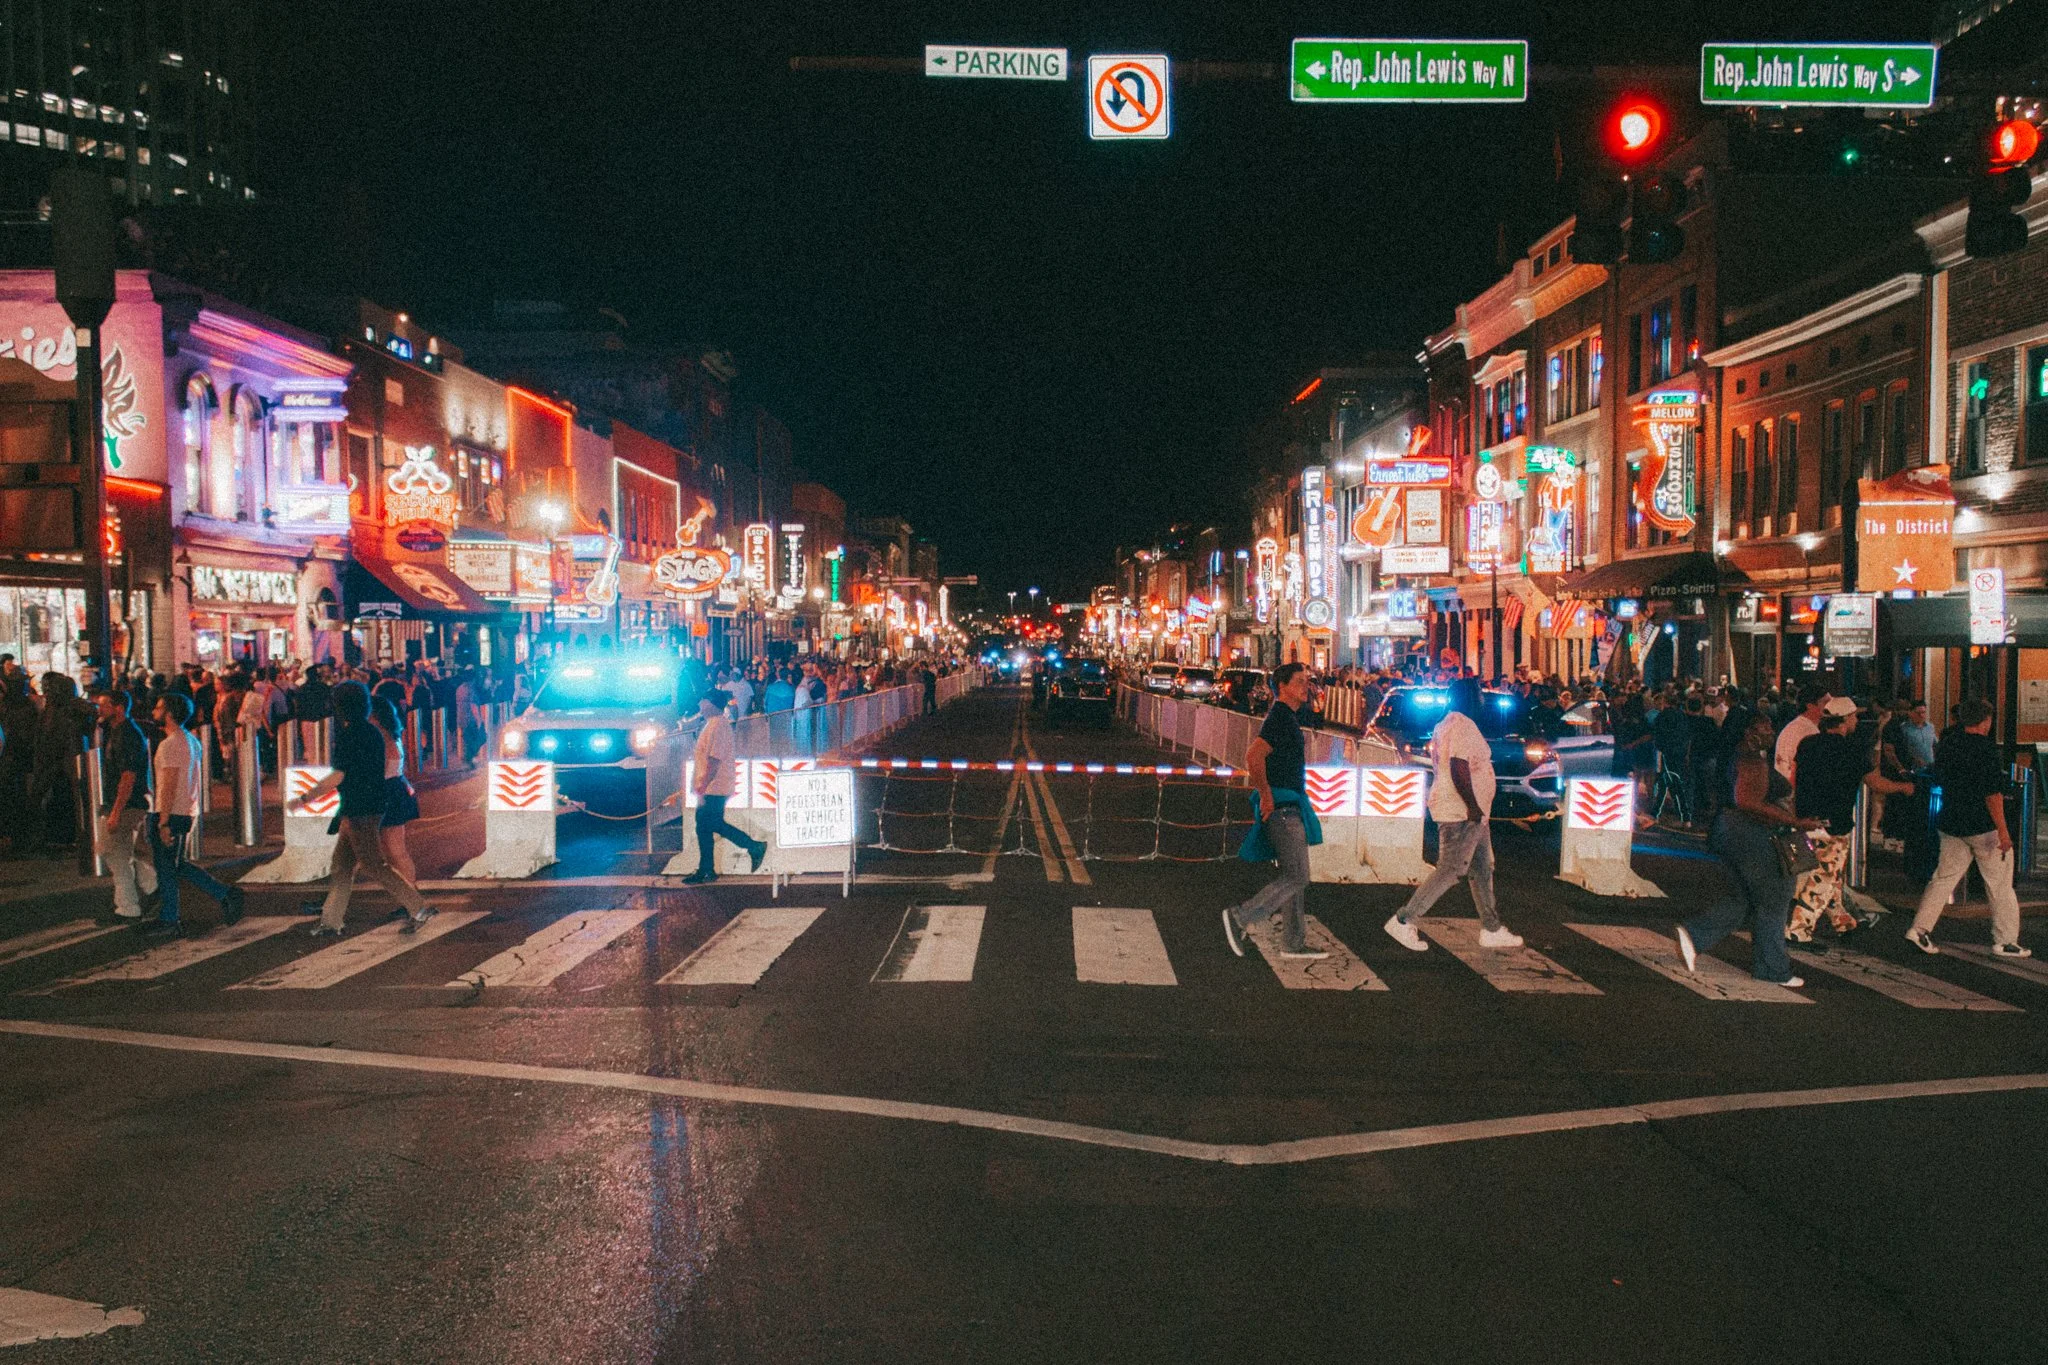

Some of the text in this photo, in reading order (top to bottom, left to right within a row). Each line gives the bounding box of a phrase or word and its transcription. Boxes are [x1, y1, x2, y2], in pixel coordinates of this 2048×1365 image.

[955, 51, 1060, 76] PARKING
[1331, 50, 1515, 91] Rep. John Lewis Way N
[1713, 54, 1894, 94] Rep. John Lewis Way S
[1651, 407, 1696, 419] MELLOW
[1666, 423, 1683, 516] MUSHROOM
[1305, 470, 1322, 597] FRIENDS
[1864, 518, 1949, 535] The District
[1650, 585, 1677, 596] Pizza
[1682, 583, 1716, 594] Spirits
[1388, 590, 1416, 618] ICE
[786, 794, 843, 808] PEDESTRIAN
[785, 809, 845, 825] OR VEHICLE
[797, 825, 835, 840] TRAFFIC
